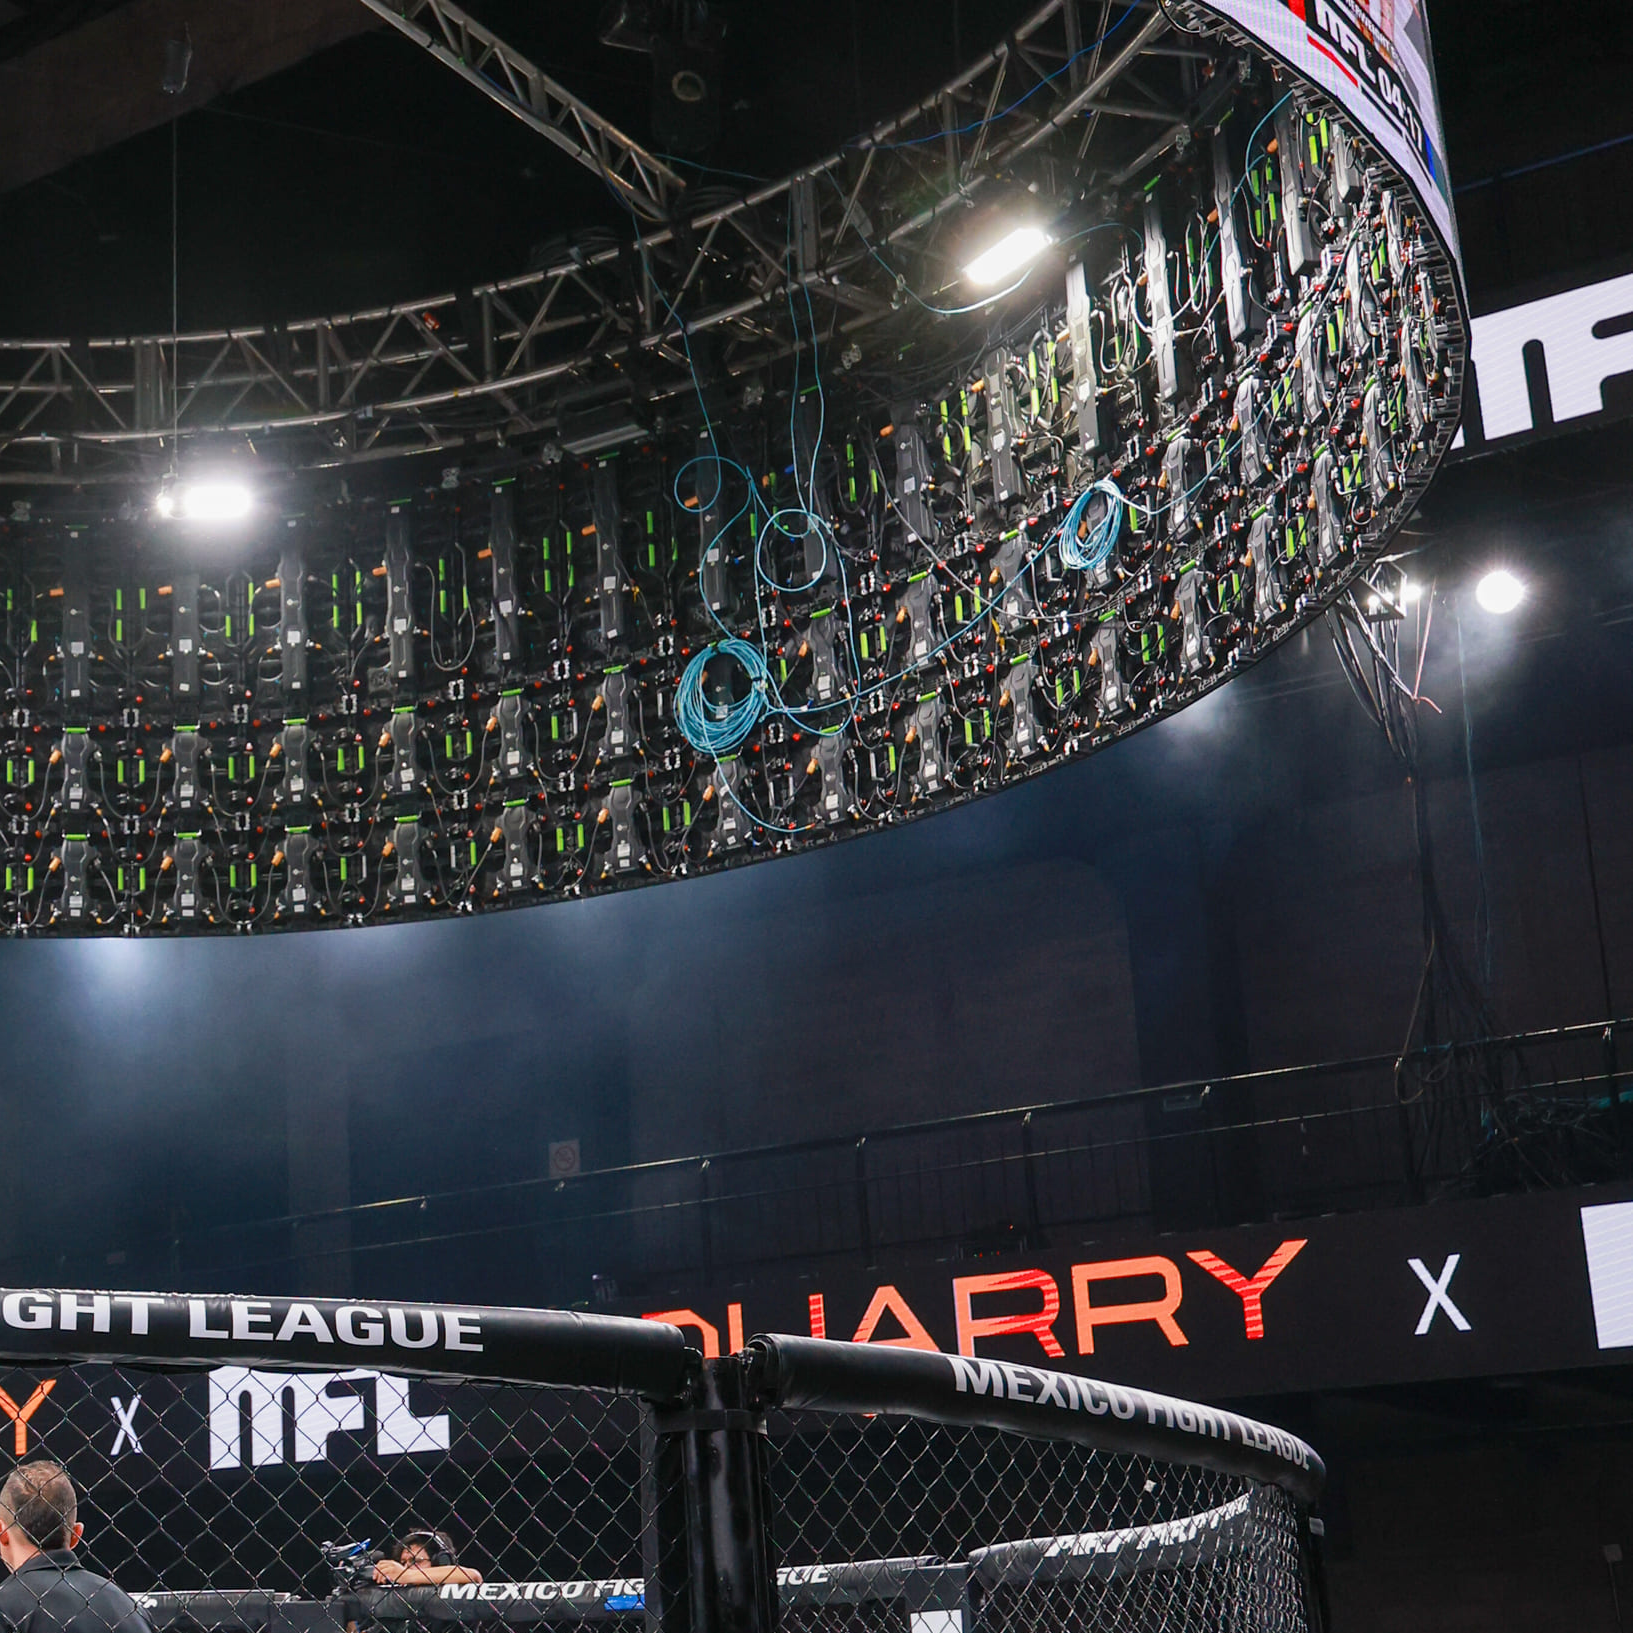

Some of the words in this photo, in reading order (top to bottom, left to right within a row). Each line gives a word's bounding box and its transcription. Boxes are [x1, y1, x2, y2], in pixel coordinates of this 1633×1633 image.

[188, 1299, 485, 1353] LEAGUE
[1408, 1253, 1472, 1335] X
[108, 1394, 142, 1456] X
[208, 1365, 450, 1471] MFL
[947, 1356, 1136, 1420] MEXICO
[1144, 1396, 1235, 1442] FIGHT
[1235, 1412, 1311, 1471] LEAGUE
[440, 1581, 584, 1602] MEXICO
